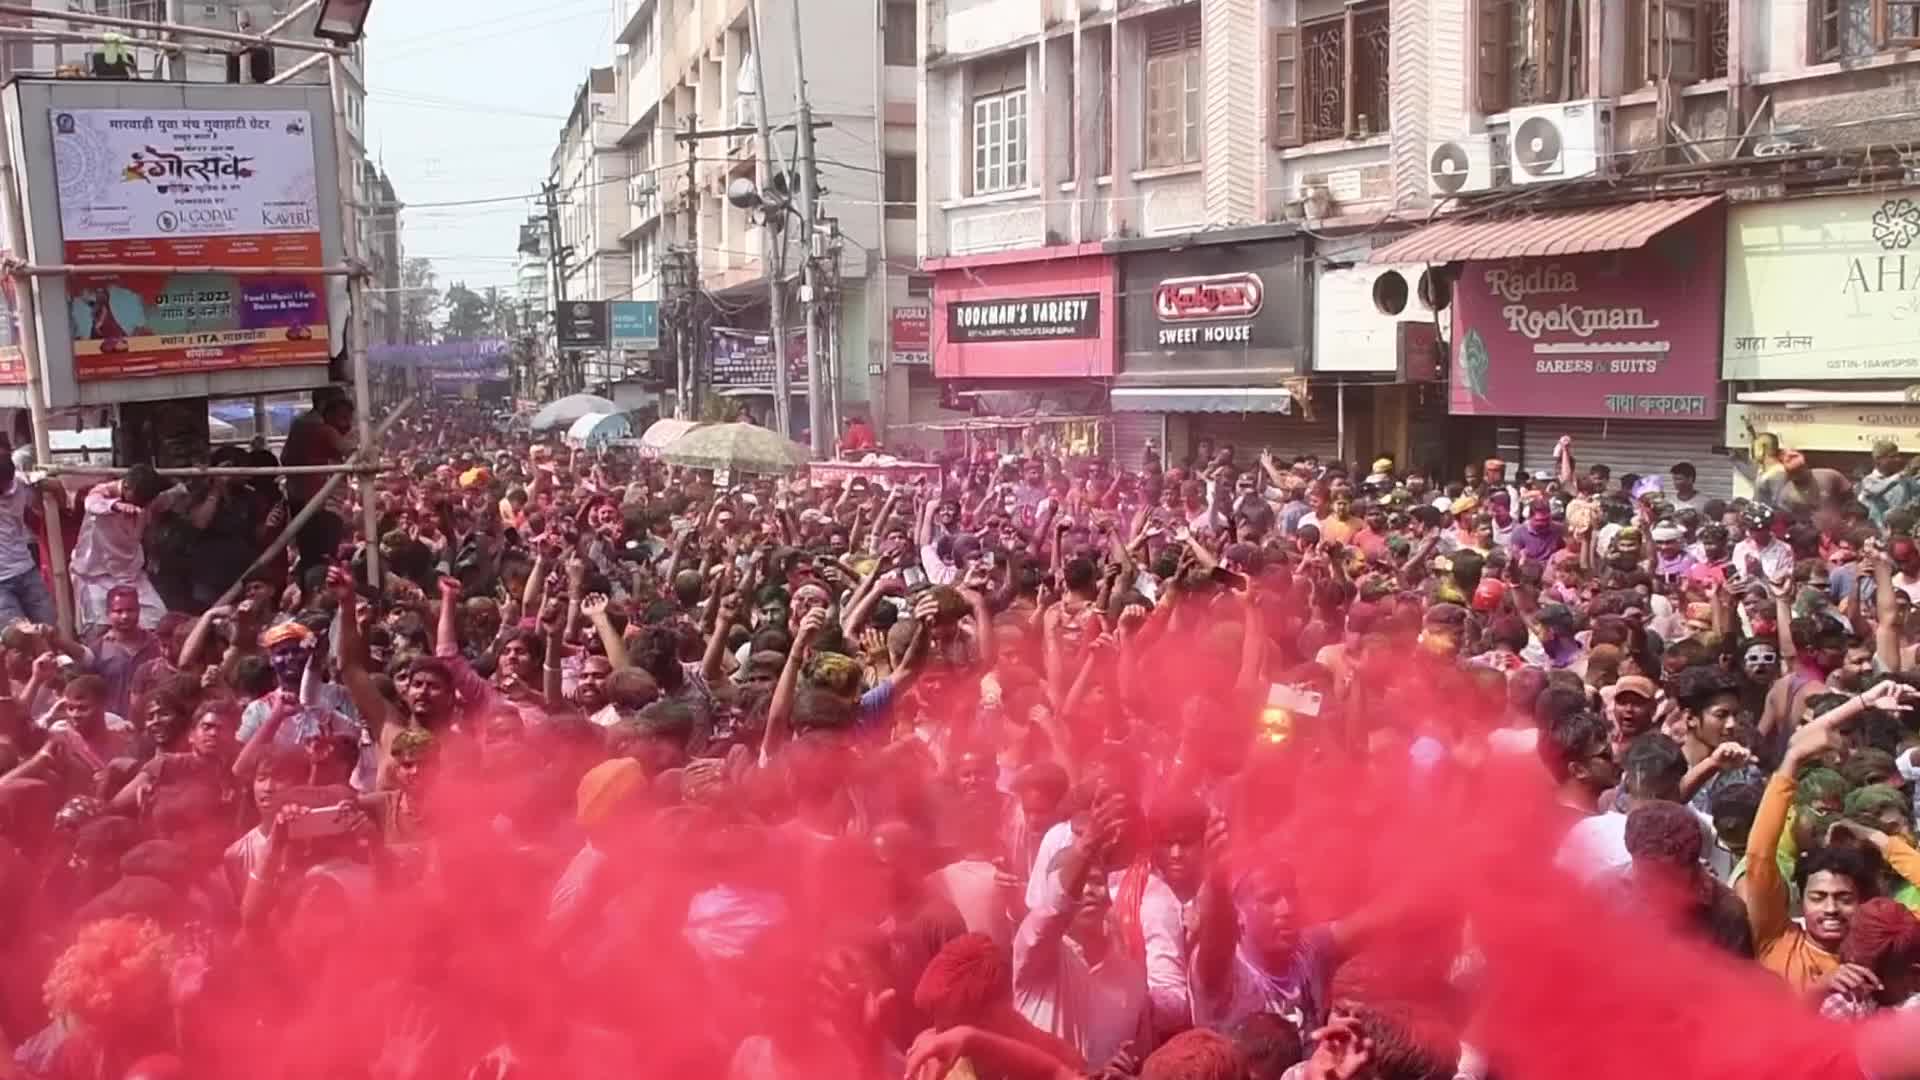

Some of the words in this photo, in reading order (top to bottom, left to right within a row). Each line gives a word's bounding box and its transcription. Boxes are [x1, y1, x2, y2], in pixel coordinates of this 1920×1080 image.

[204, 116, 246, 132] गुवाहाटी
[1485, 264, 1579, 302] Radha
[198, 291, 231, 302] 2023
[956, 303, 1028, 327] ROOKMAN'S
[1032, 300, 1088, 323] VARIETY
[1503, 304, 1660, 338] Rookman
[197, 334, 219, 344] ITA
[1160, 328, 1198, 344] SWEET
[1204, 326, 1250, 341] HOUSE
[1735, 336, 1766, 350] आहा
[1536, 359, 1592, 374] SAREES
[1610, 358, 1656, 373] SUITS
